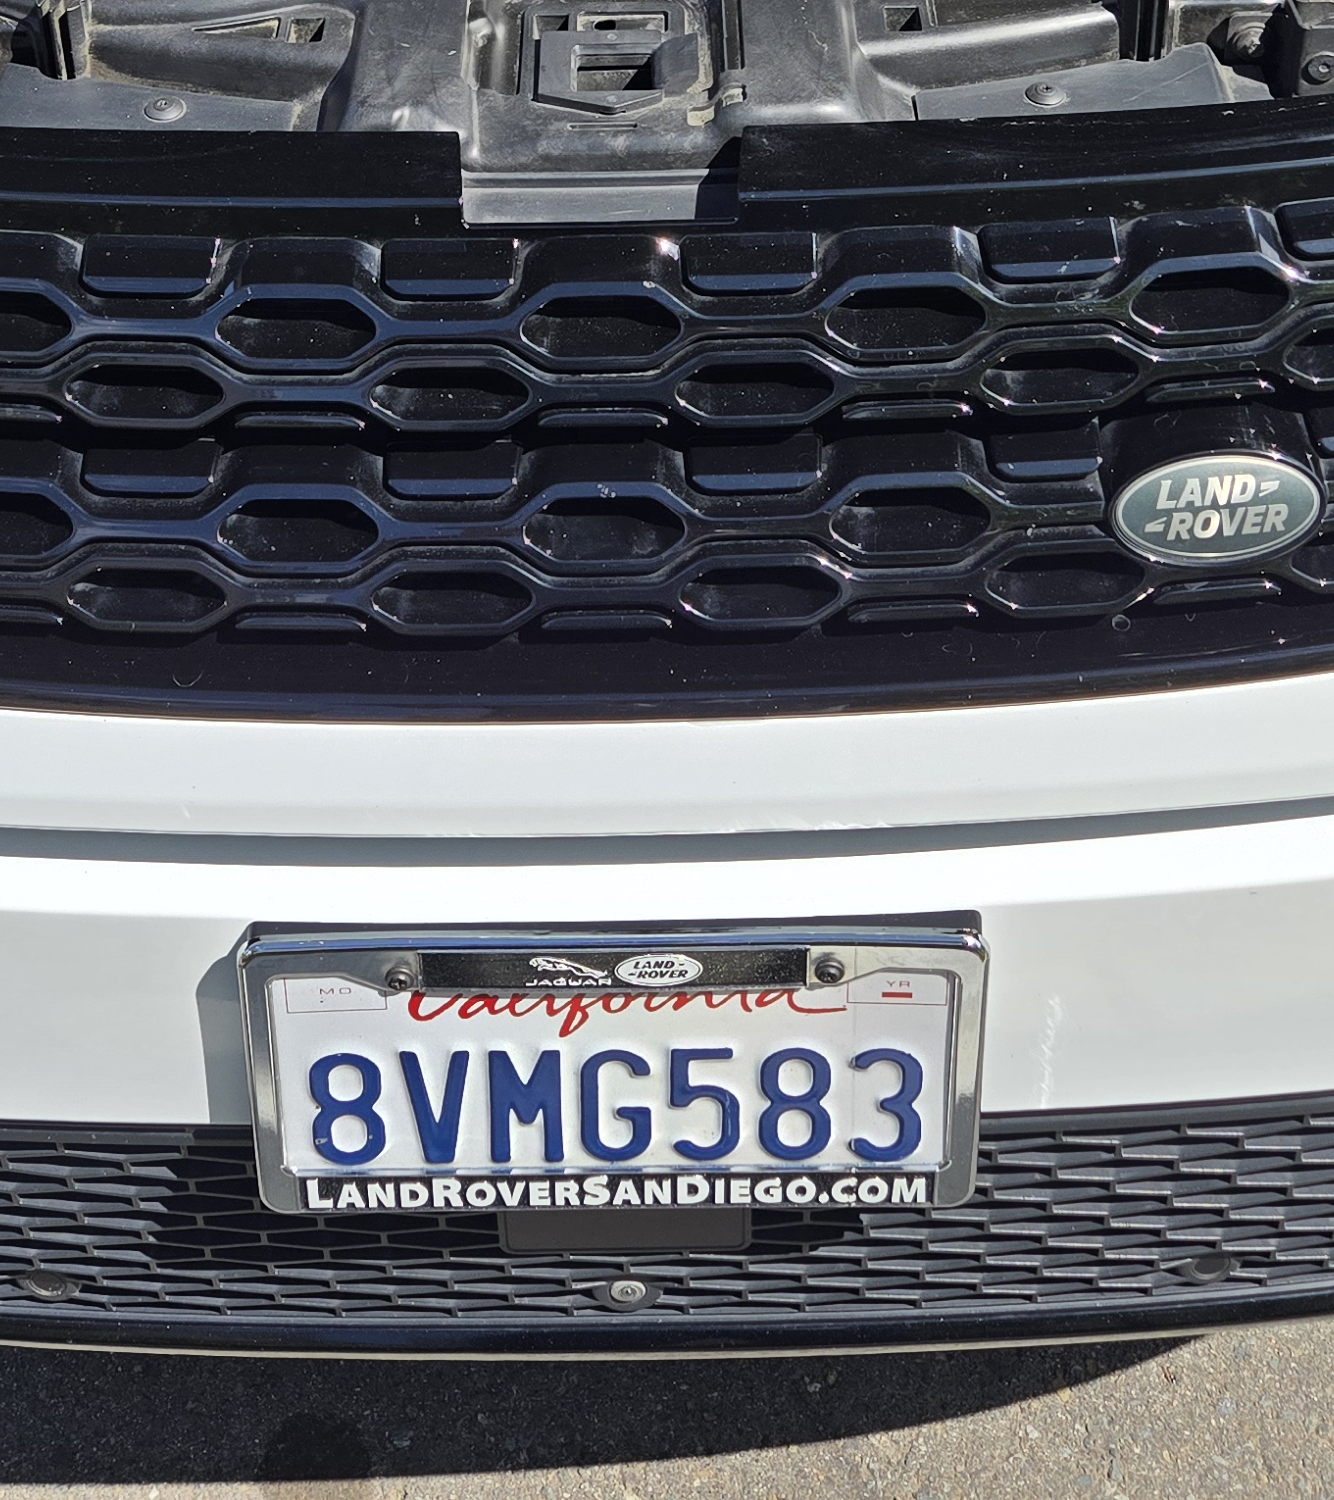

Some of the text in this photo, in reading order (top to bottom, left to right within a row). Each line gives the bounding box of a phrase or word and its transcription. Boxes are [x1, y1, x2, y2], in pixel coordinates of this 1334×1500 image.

[1155, 473, 1256, 510] LAND
[1166, 503, 1289, 541] ROVER
[632, 960, 675, 970] LAND
[635, 968, 689, 980] ROVER
[525, 977, 612, 987] JAGUAR
[885, 979, 911, 988] YR
[318, 986, 353, 996] MO
[308, 1047, 924, 1166] 8VMG583
